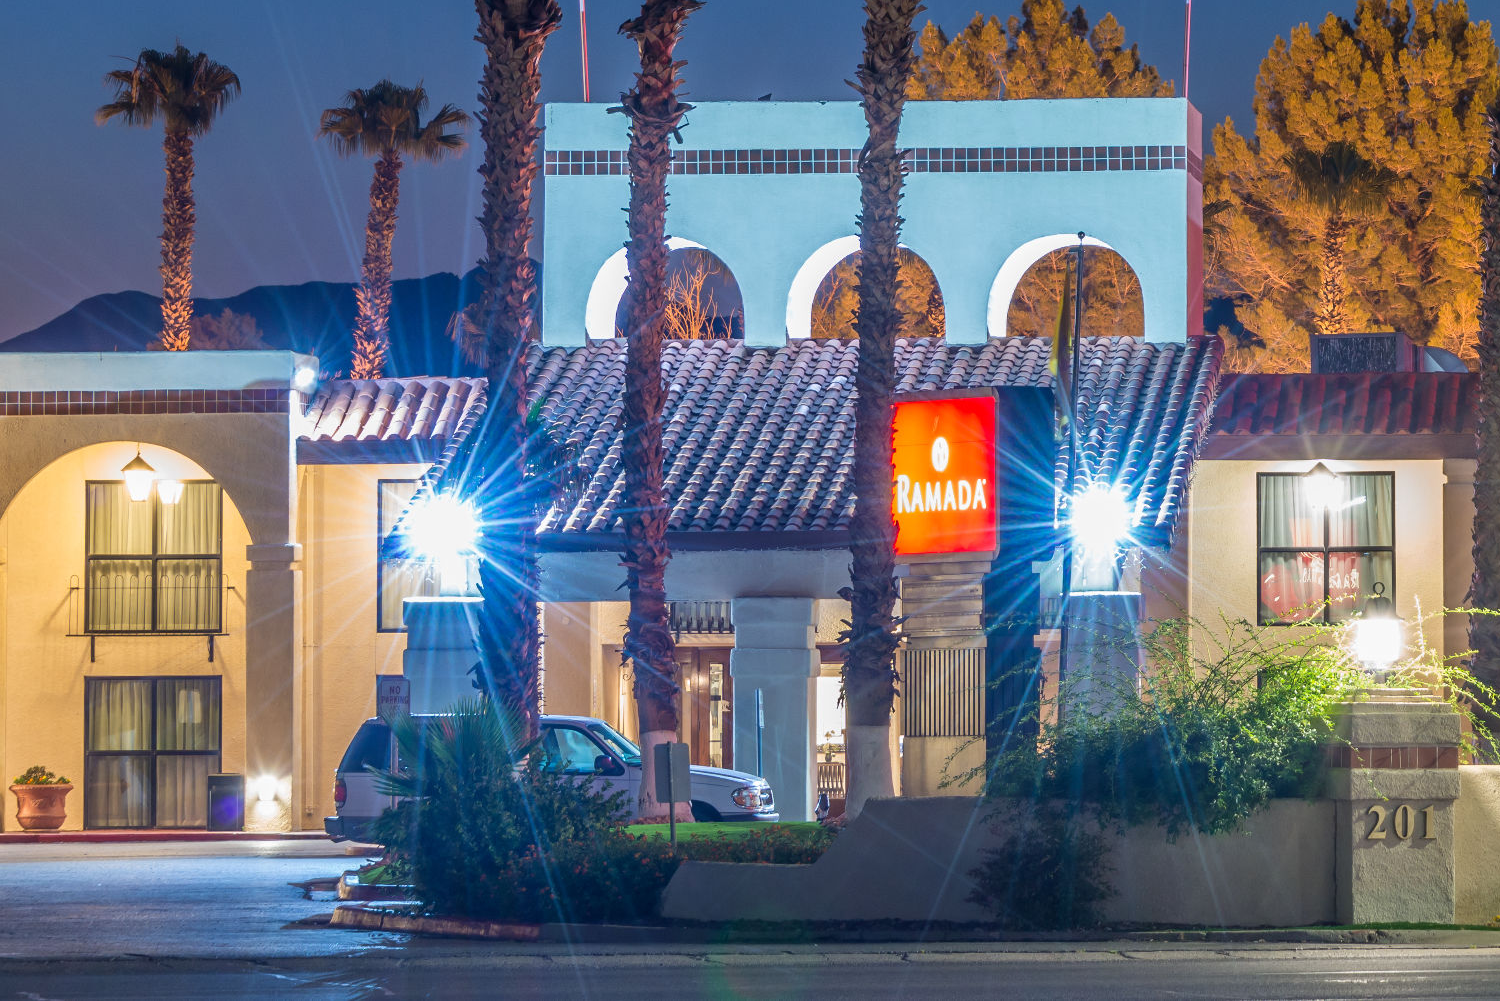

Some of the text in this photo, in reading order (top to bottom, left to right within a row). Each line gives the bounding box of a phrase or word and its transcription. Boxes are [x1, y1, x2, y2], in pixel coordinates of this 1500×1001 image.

[897, 474, 987, 513] RAMADA
[381, 695, 409, 704] PARKING
[390, 685, 400, 695] NO
[1366, 804, 1437, 840] 201
